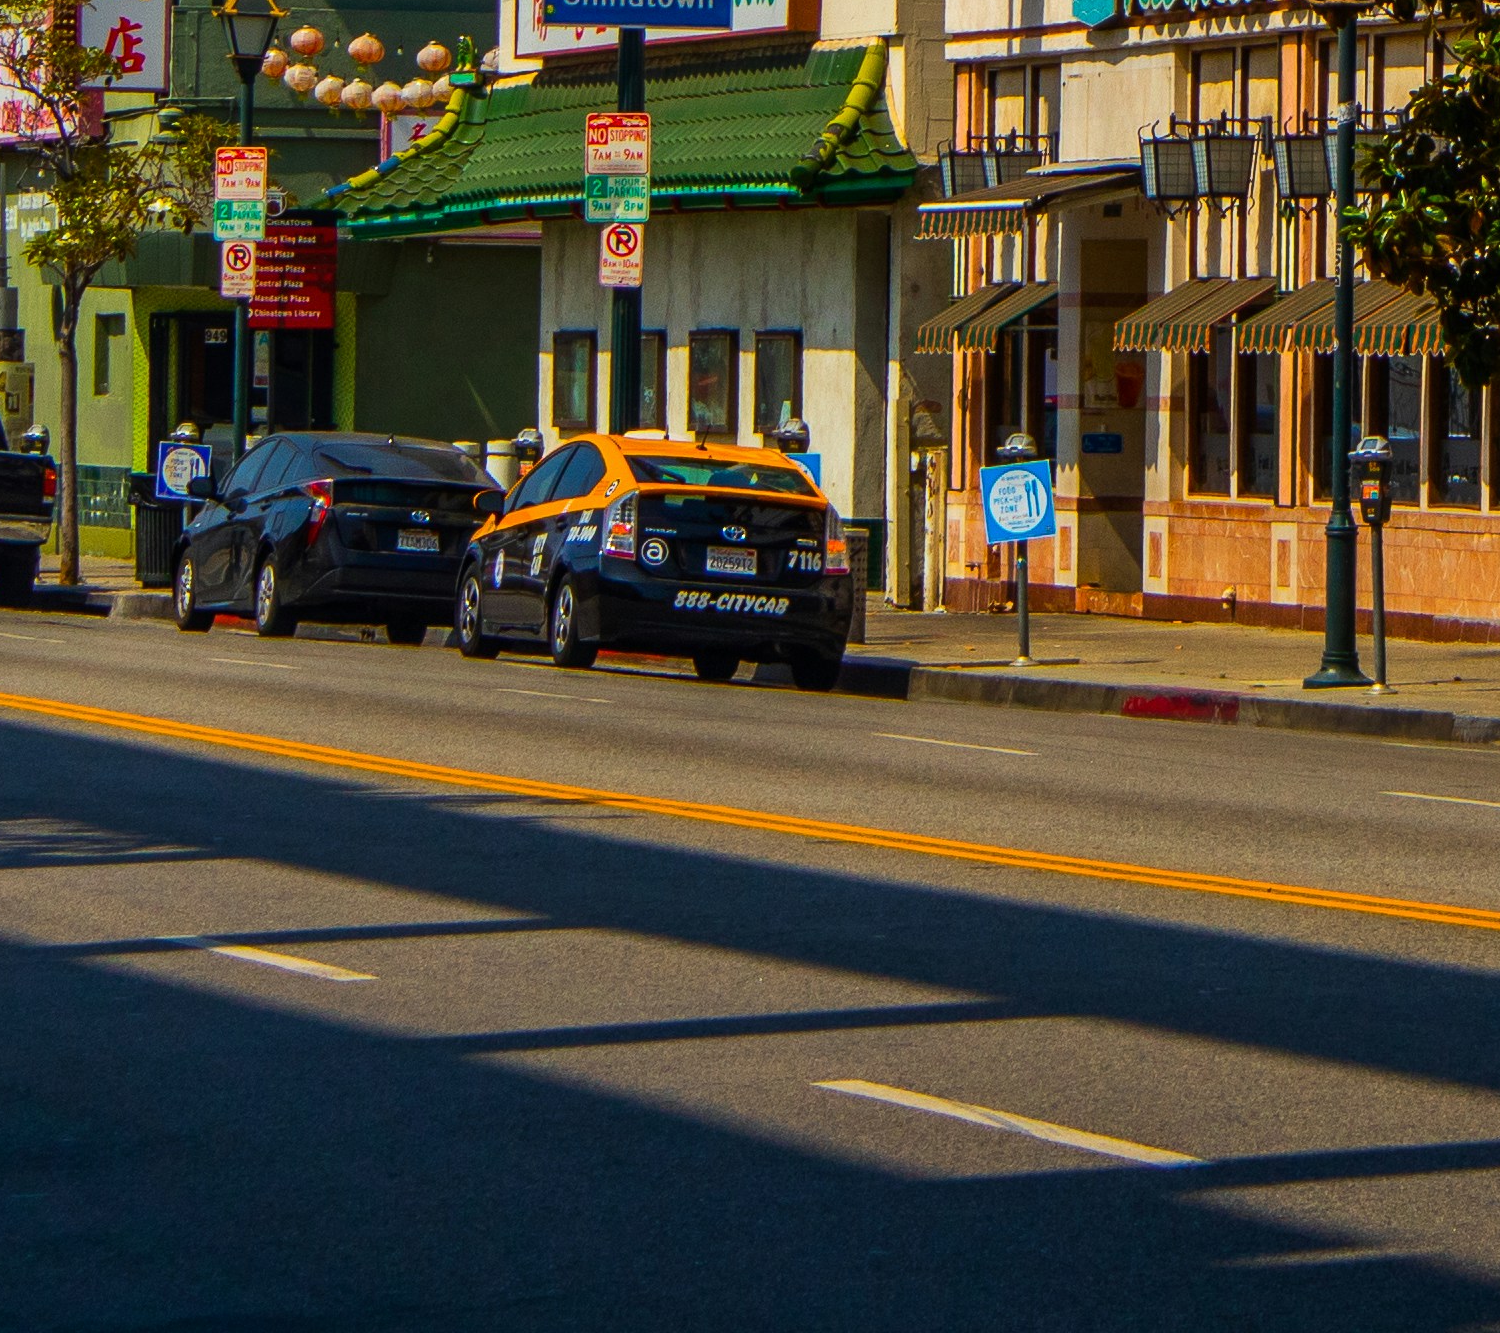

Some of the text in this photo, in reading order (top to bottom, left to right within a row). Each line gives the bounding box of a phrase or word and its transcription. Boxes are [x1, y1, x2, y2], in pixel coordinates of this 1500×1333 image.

[588, 127, 647, 144] NO STOPPING
[592, 148, 612, 161] 7AM
[623, 148, 644, 161] 9AM
[218, 160, 263, 174] NO STOPPING
[591, 179, 603, 196] 2
[608, 186, 646, 199] PARKING
[220, 204, 229, 218] 2
[591, 199, 644, 212] 9AM 8PM
[265, 218, 313, 226] CHINATOWN
[254, 309, 293, 318] Chinatown
[205, 329, 228, 343] 949
[787, 549, 823, 572] 7116
[673, 589, 790, 616] 888-CITYCAB
